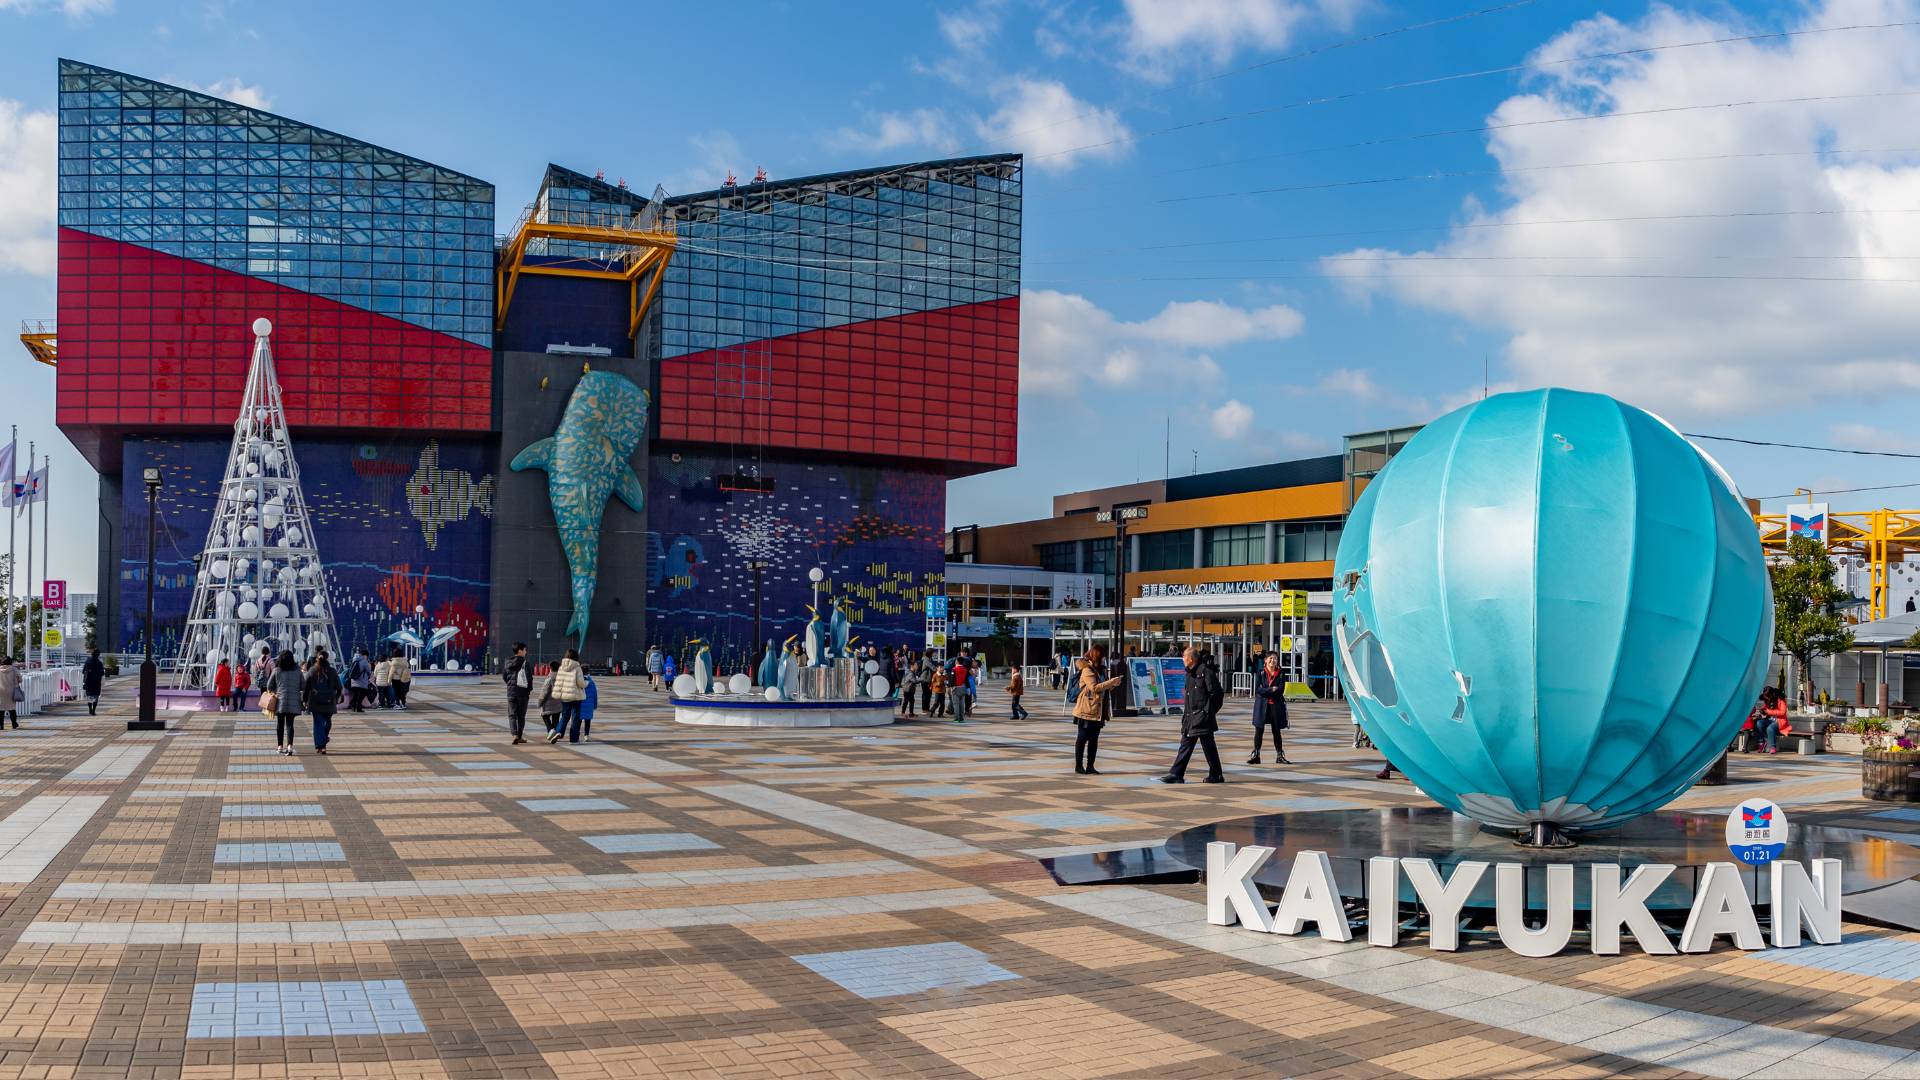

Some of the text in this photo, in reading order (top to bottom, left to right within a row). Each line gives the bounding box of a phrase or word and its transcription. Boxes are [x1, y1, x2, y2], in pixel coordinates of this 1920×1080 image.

[48, 583, 59, 598] B
[1168, 580, 1279, 596] OSAKA AQUARIUM KAIYUKAN
[1744, 851, 1770, 861] 01.21
[1207, 841, 1842, 957] KAIYUKAN
